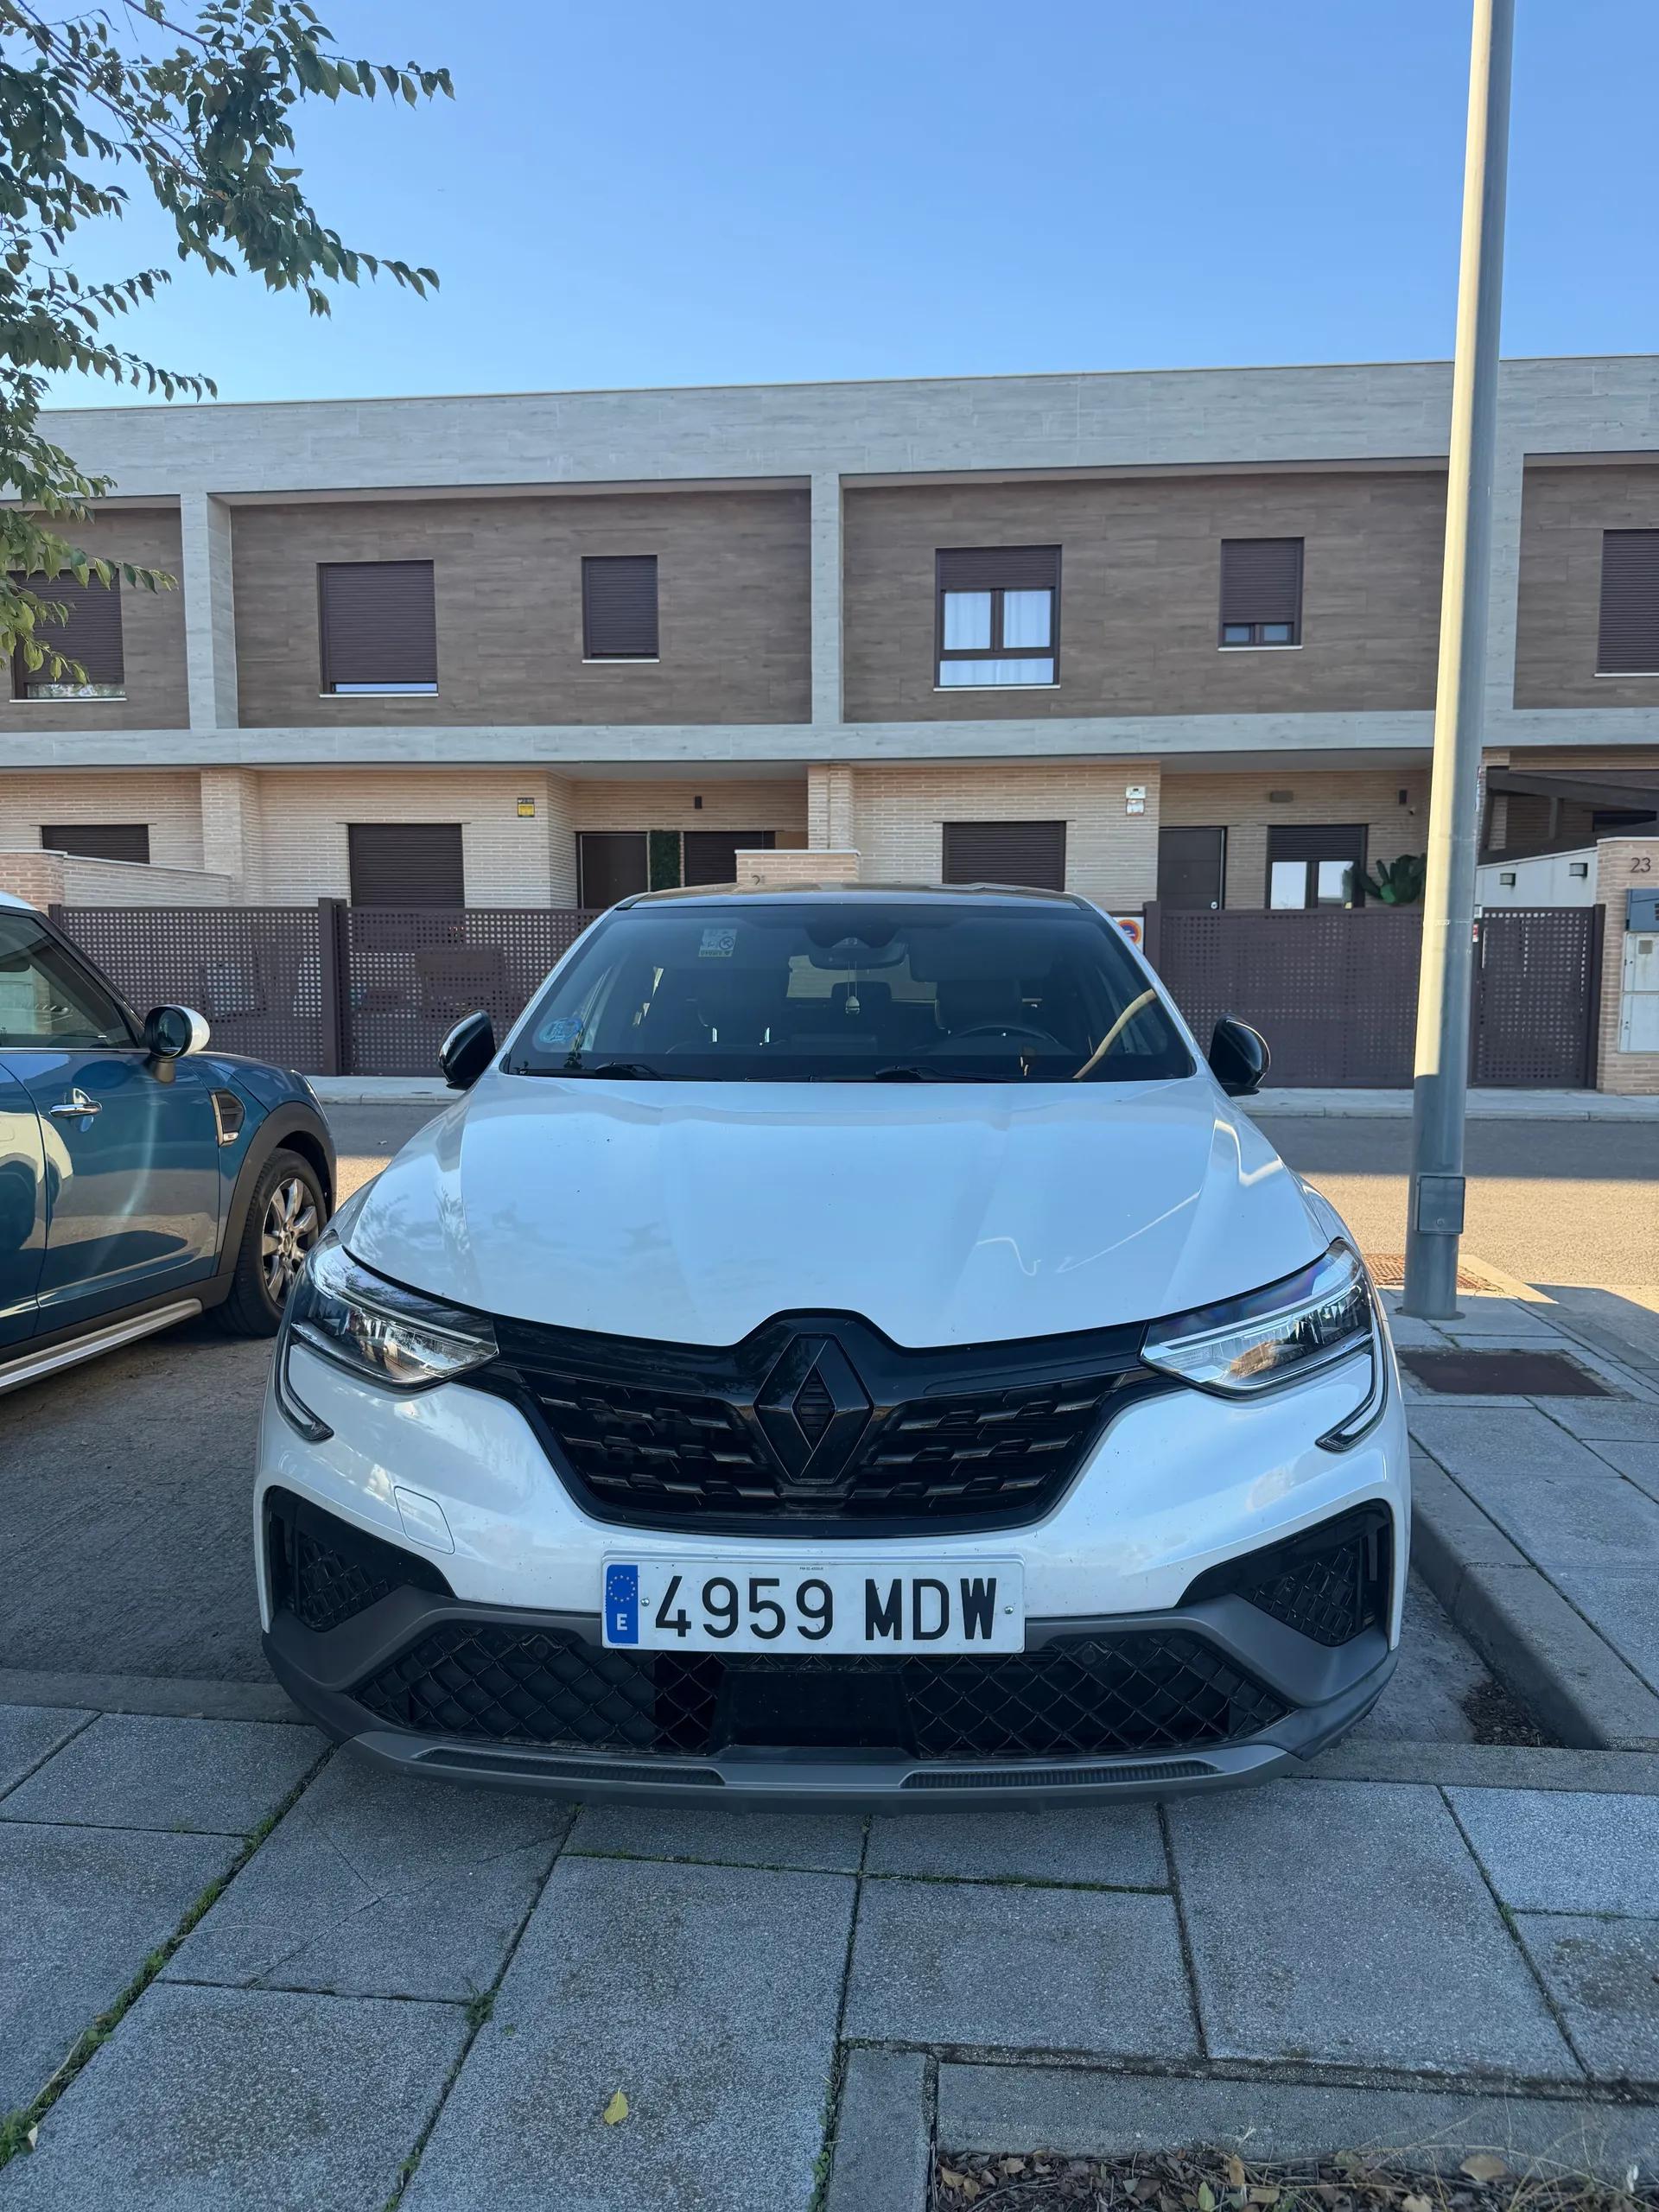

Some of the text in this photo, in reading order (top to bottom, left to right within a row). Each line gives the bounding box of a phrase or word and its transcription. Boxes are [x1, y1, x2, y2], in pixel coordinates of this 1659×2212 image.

[1630, 857, 1651, 874] 23
[655, 1575, 997, 1641] 4959 MDW
[616, 1613, 628, 1630] E
